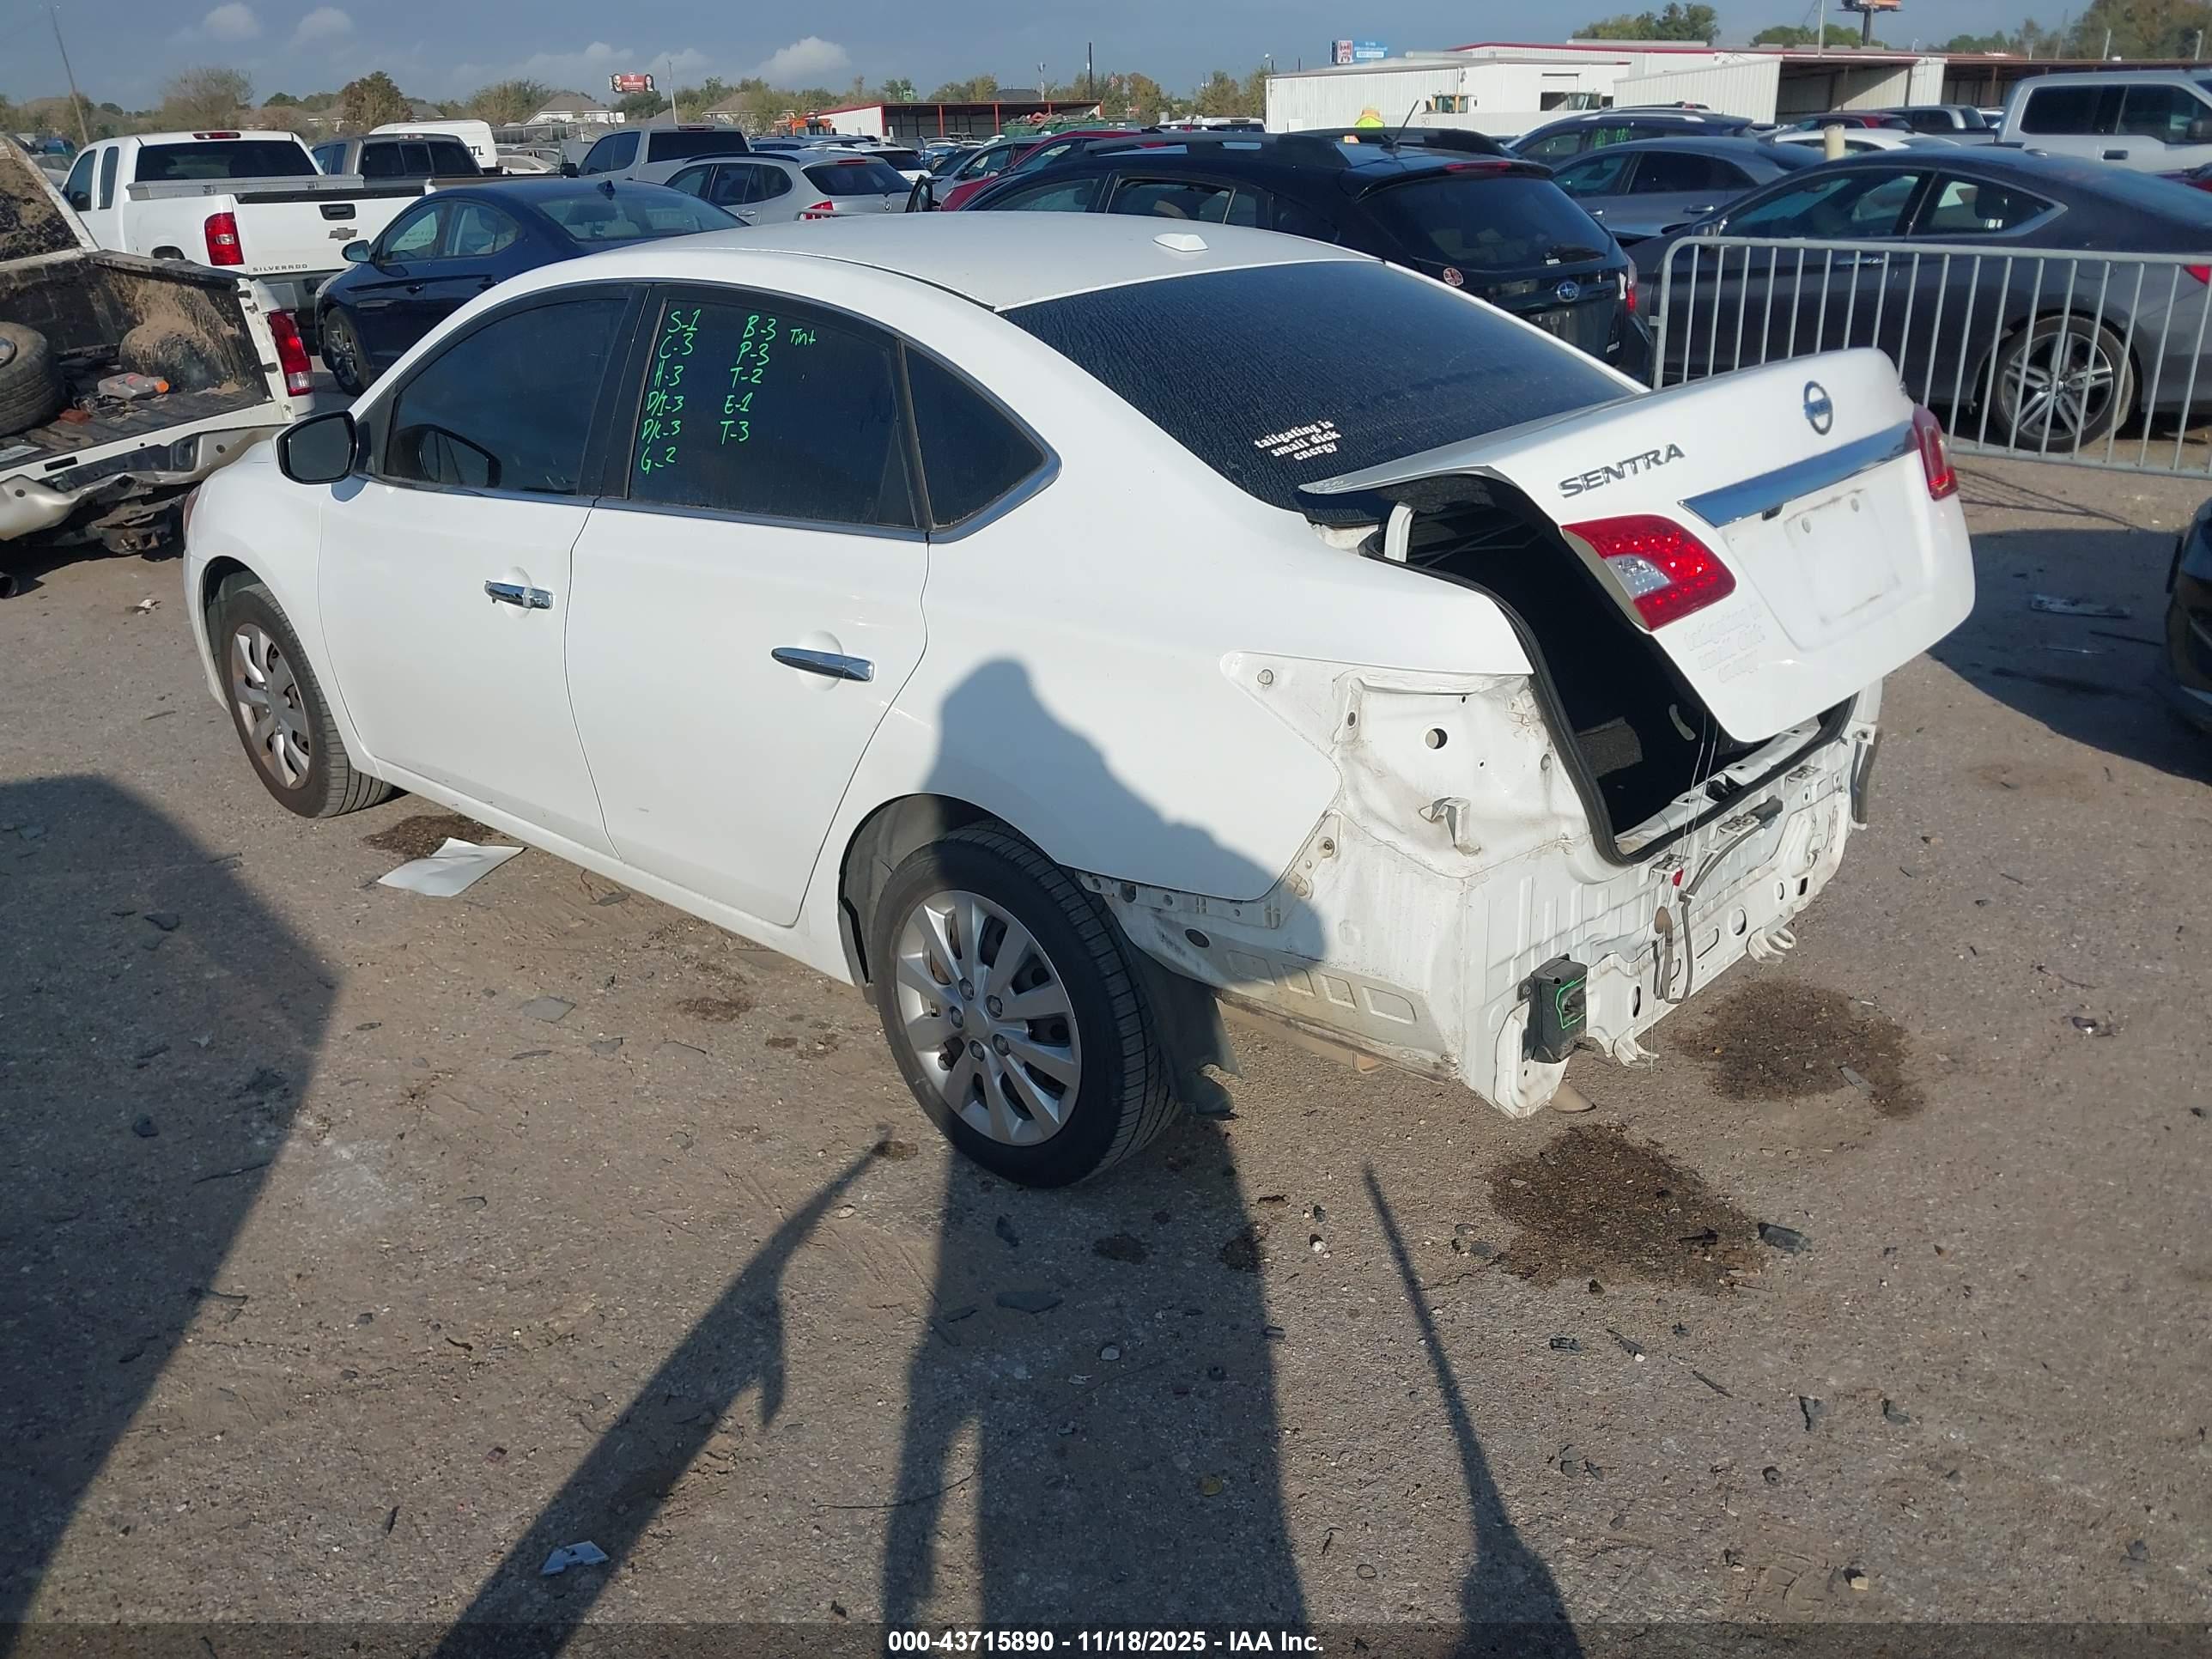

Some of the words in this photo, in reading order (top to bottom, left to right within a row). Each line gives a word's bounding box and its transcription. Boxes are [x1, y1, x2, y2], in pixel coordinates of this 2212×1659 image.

[743, 315, 778, 340] B-3
[789, 328, 817, 347] Tint
[737, 342, 770, 366] P-3
[730, 367, 763, 388] T-2
[725, 392, 754, 414] E-1
[720, 421, 749, 445] T-3
[1255, 423, 1322, 448] tailgating
[1317, 420, 1334, 429] is
[1271, 439, 1310, 457] small
[1310, 430, 1341, 445] dick
[1294, 442, 1338, 460] energy
[1559, 443, 1685, 498] SENTRA
